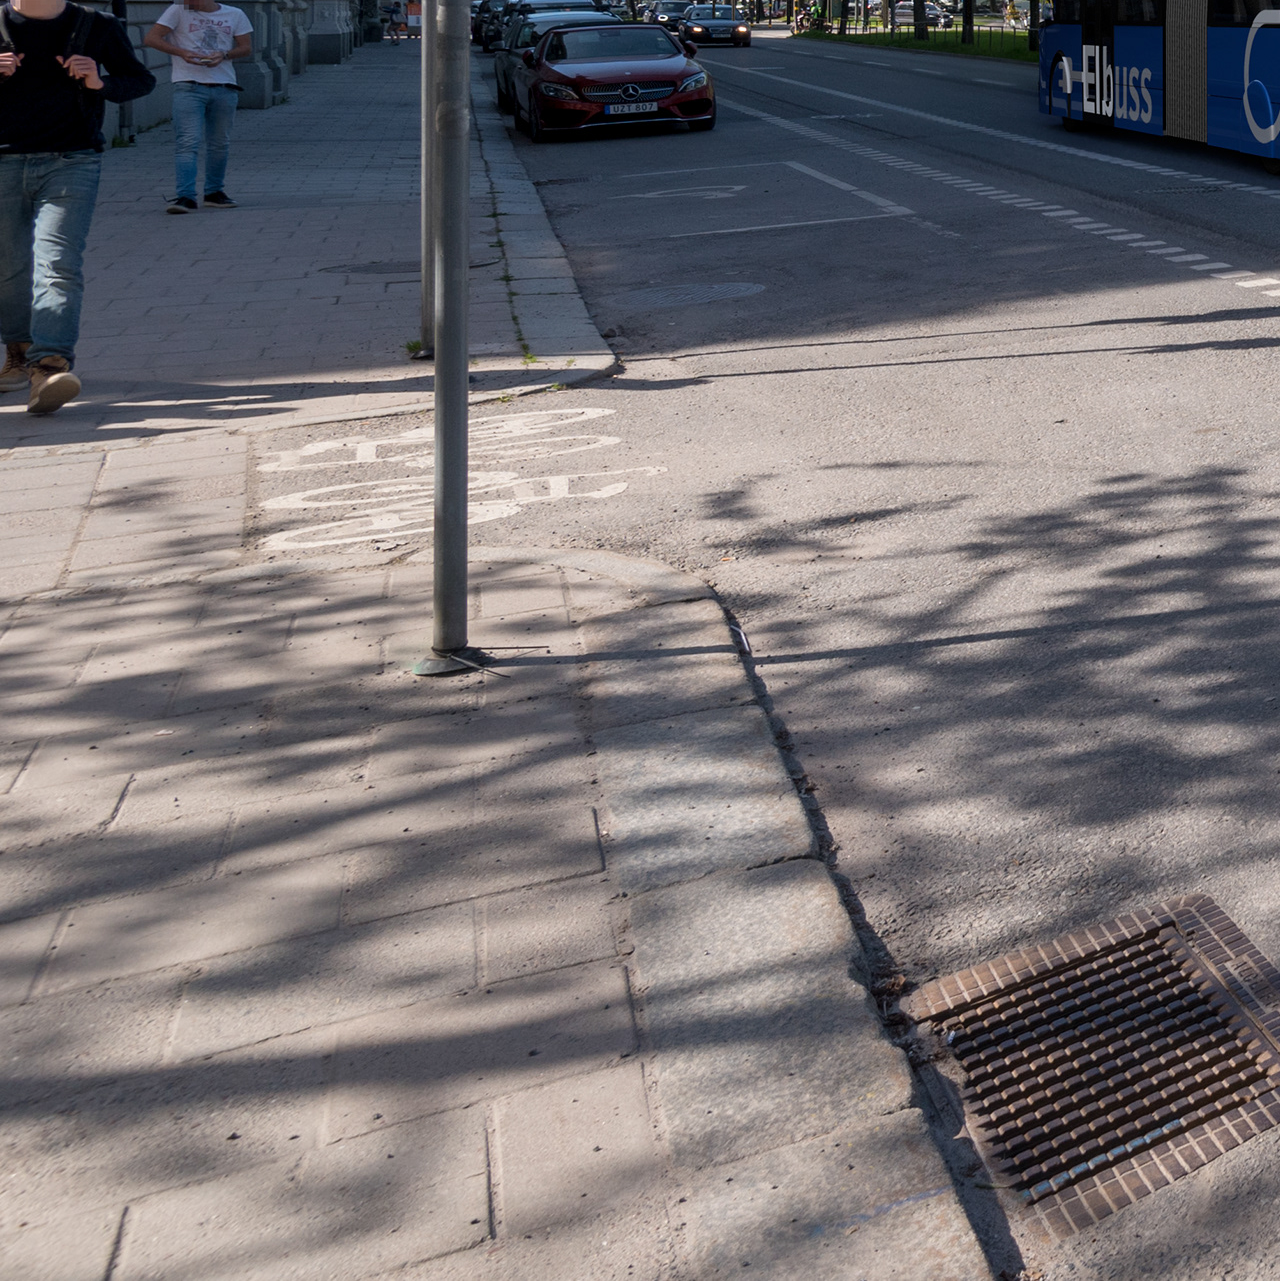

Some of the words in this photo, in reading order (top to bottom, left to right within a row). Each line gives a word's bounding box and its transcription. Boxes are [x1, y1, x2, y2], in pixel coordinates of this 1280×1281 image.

[1082, 44, 1152, 124] Elbuss
[613, 104, 632, 113] UZT
[635, 103, 654, 112] 807
